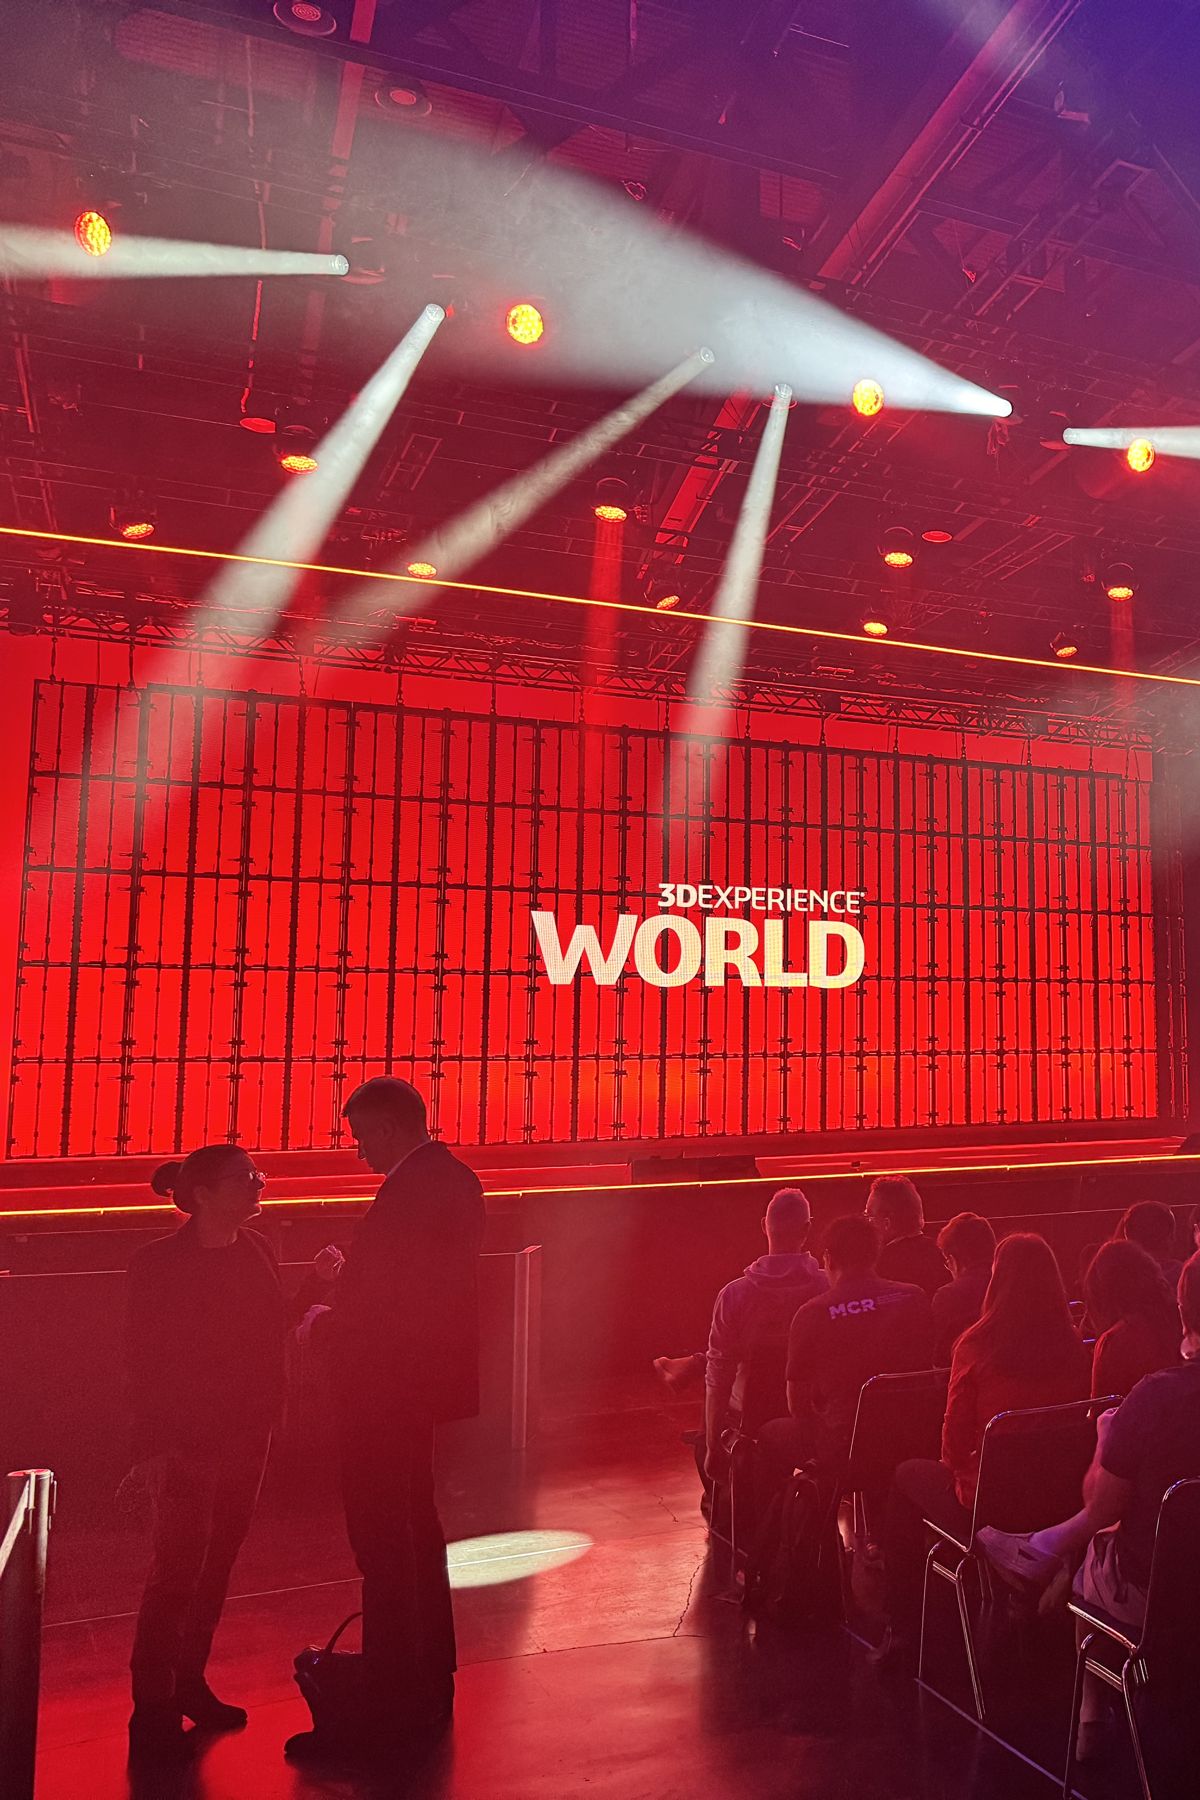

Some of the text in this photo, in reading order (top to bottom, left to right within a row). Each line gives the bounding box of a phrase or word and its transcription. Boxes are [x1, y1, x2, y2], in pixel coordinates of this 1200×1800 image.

[658, 883, 862, 914] 3DEXPERIENCE
[531, 910, 866, 989] WORLD
[829, 1299, 876, 1320] MCR
